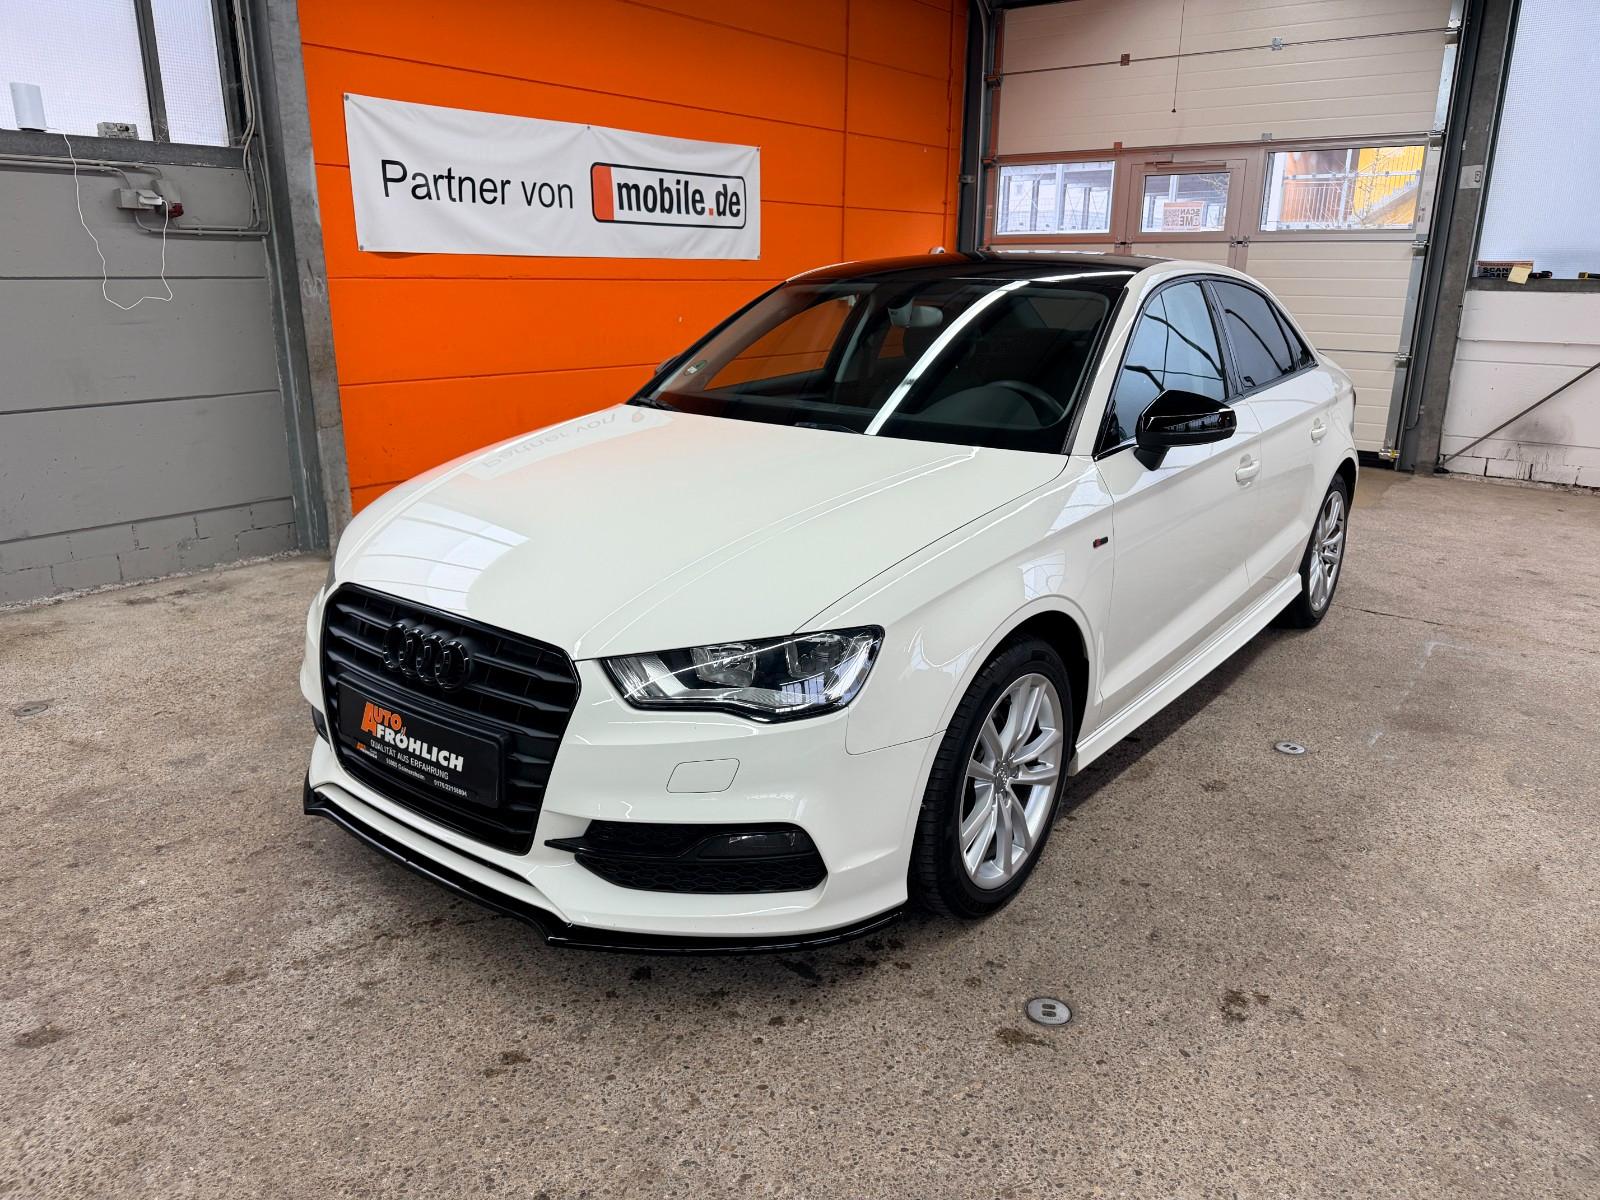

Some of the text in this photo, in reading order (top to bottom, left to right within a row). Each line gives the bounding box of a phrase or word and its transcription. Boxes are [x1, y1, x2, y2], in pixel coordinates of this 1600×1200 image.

[380, 158, 741, 218] Partner von mobile.de
[361, 701, 402, 736] AUTO
[370, 739, 397, 759] QUALITÄT
[397, 751, 410, 764] AUS
[410, 758, 449, 781] ERFAHRUNG
[376, 726, 464, 772] FRÖHLICH
